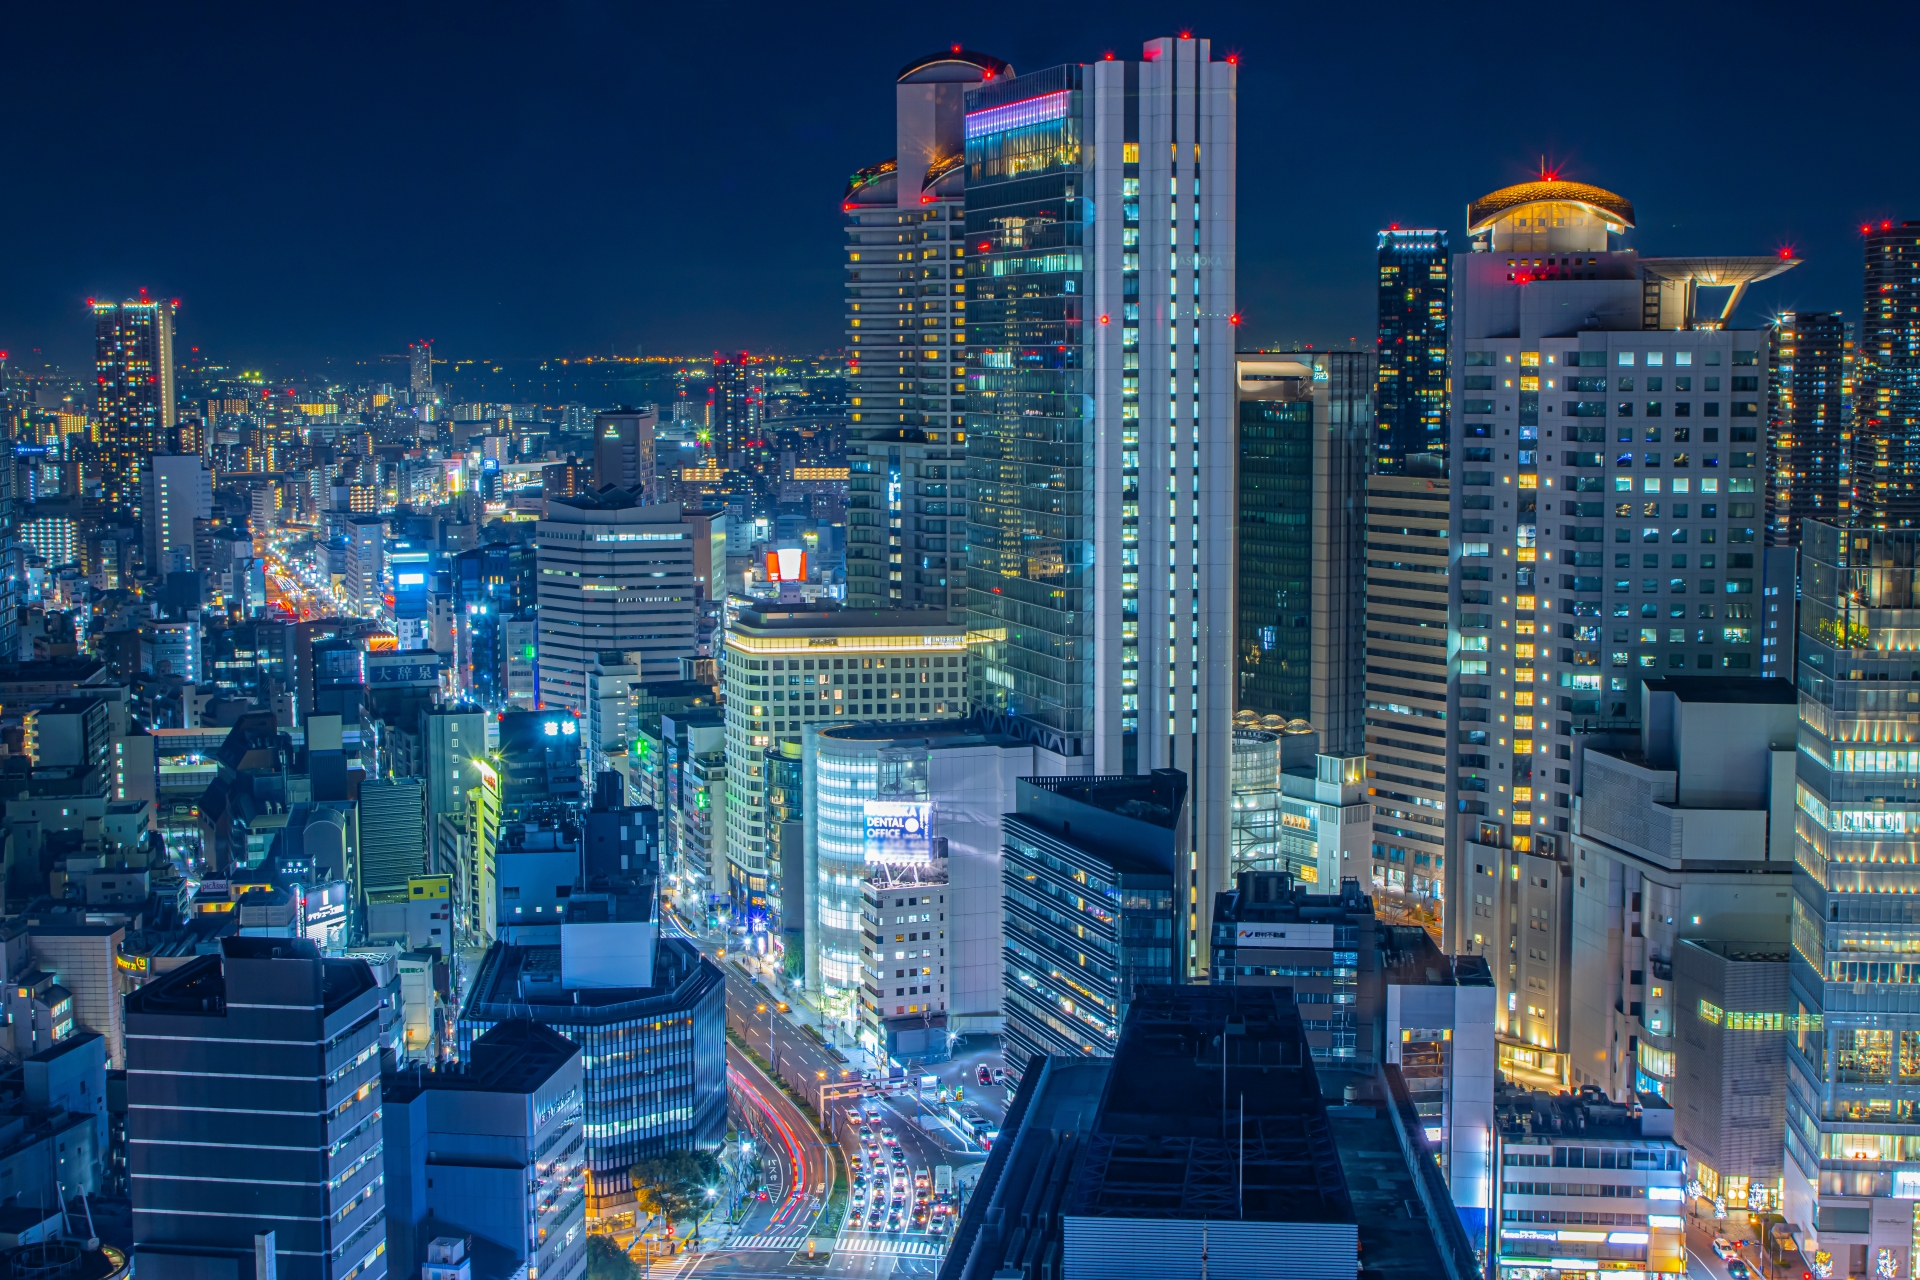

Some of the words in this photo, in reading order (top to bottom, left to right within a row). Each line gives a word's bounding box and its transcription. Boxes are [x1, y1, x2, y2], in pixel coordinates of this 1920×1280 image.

[376, 665, 432, 681] 大辞泉
[866, 817, 904, 828] DENTAL
[866, 828, 900, 838] OFFICE
[307, 904, 345, 921] クマシュー工
[768, 1160, 777, 1180] バス停
